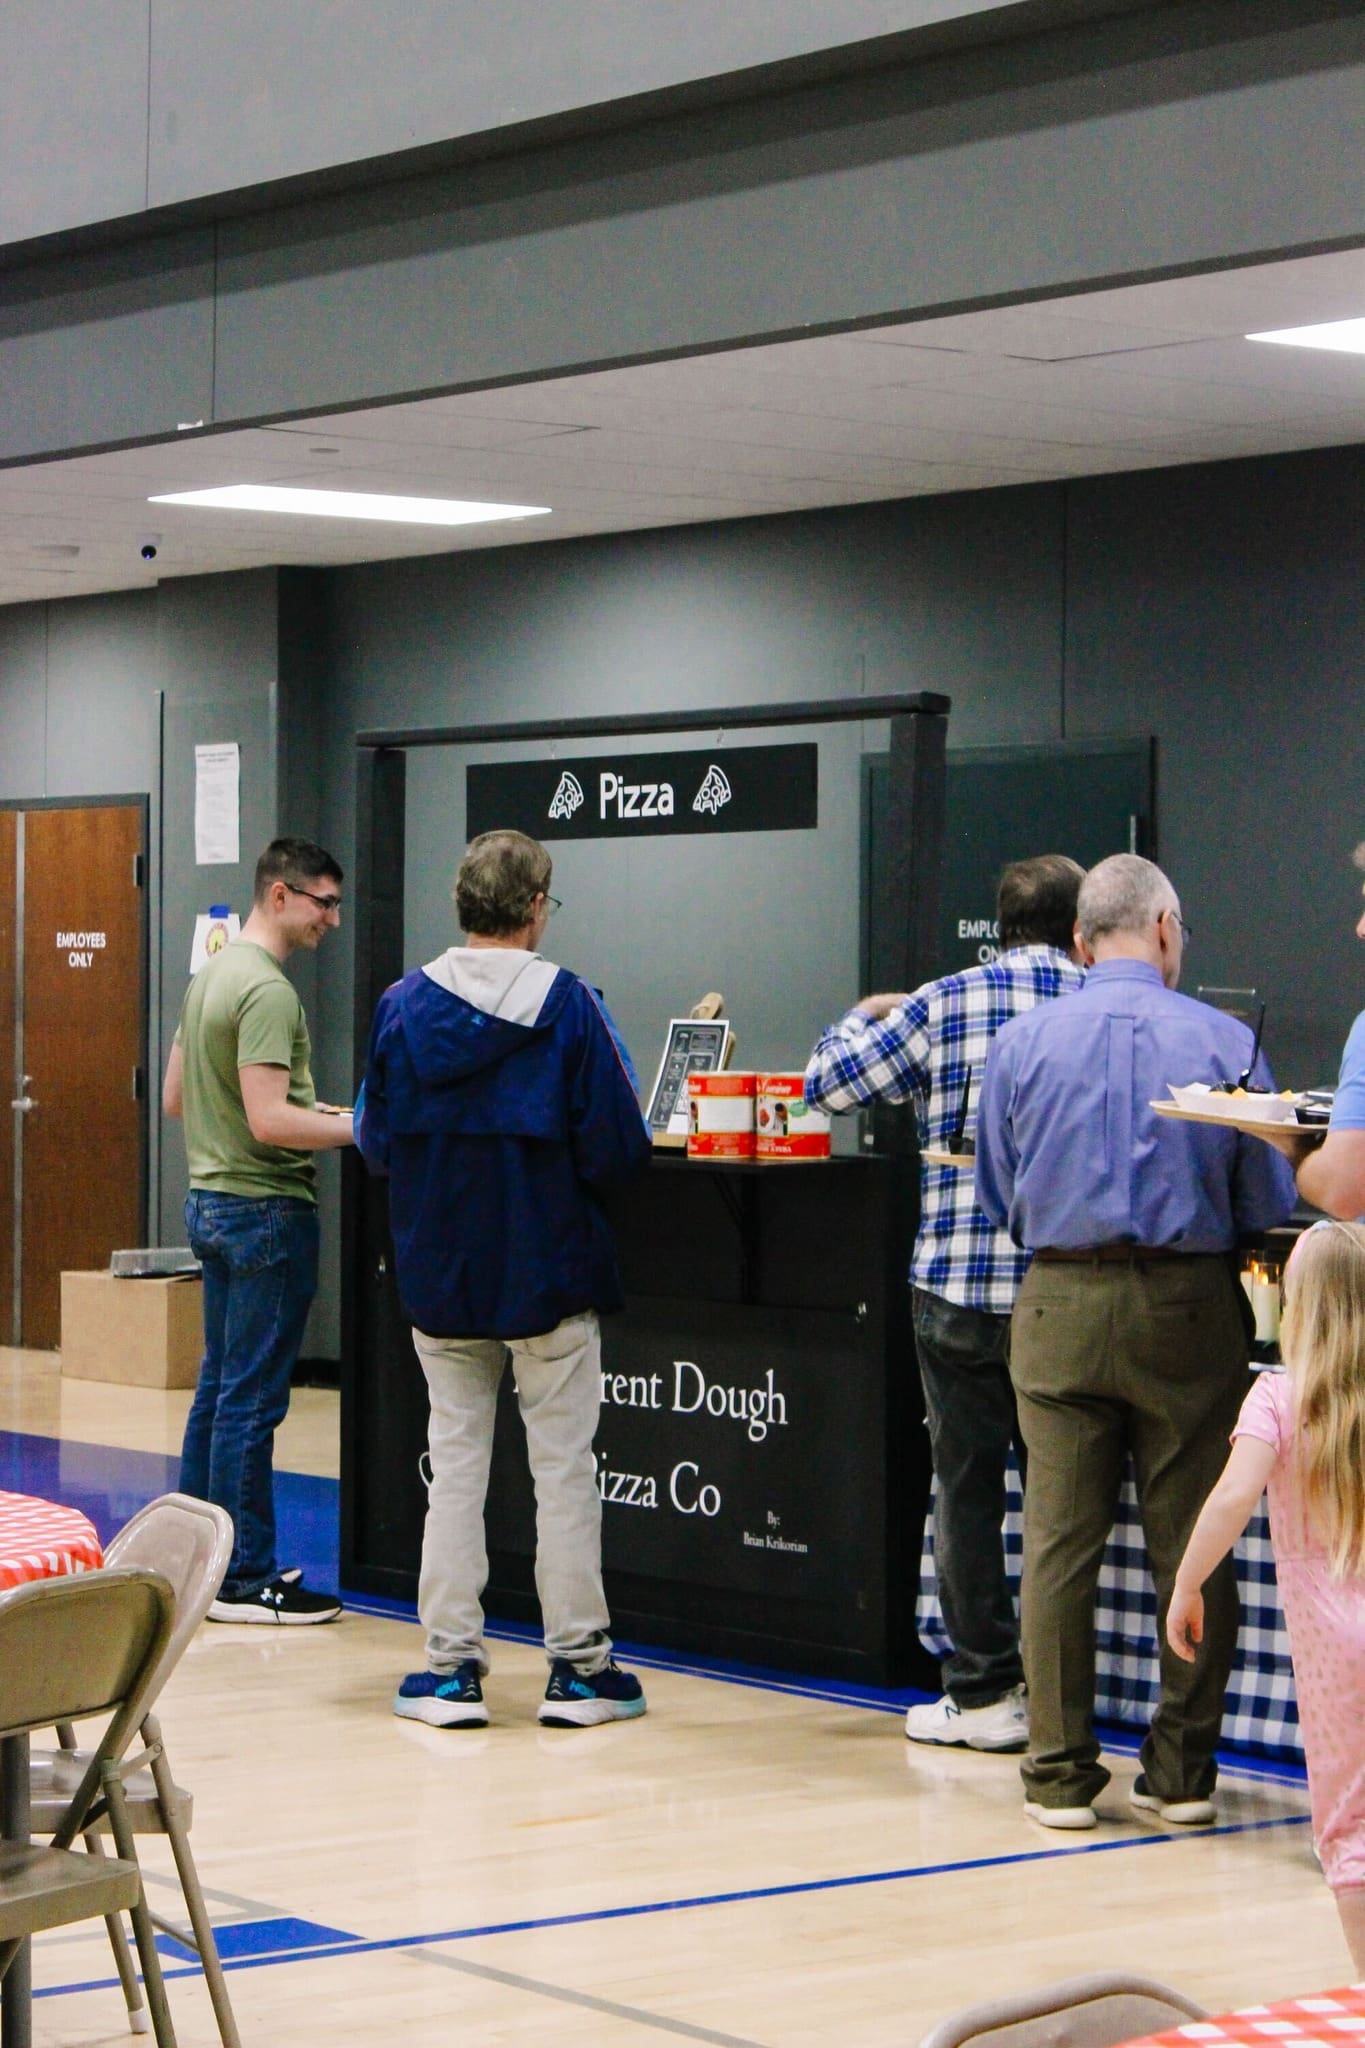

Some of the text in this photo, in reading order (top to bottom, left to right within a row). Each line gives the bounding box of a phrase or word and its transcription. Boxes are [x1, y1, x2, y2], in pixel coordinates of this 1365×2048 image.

[600, 772, 674, 820] Pizza
[56, 932, 106, 948] EMPLOYEES
[68, 951, 93, 968] ONLY
[671, 1361, 788, 1443] Dough
[669, 1461, 721, 1517] Co
[743, 1531, 764, 1547] Brian
